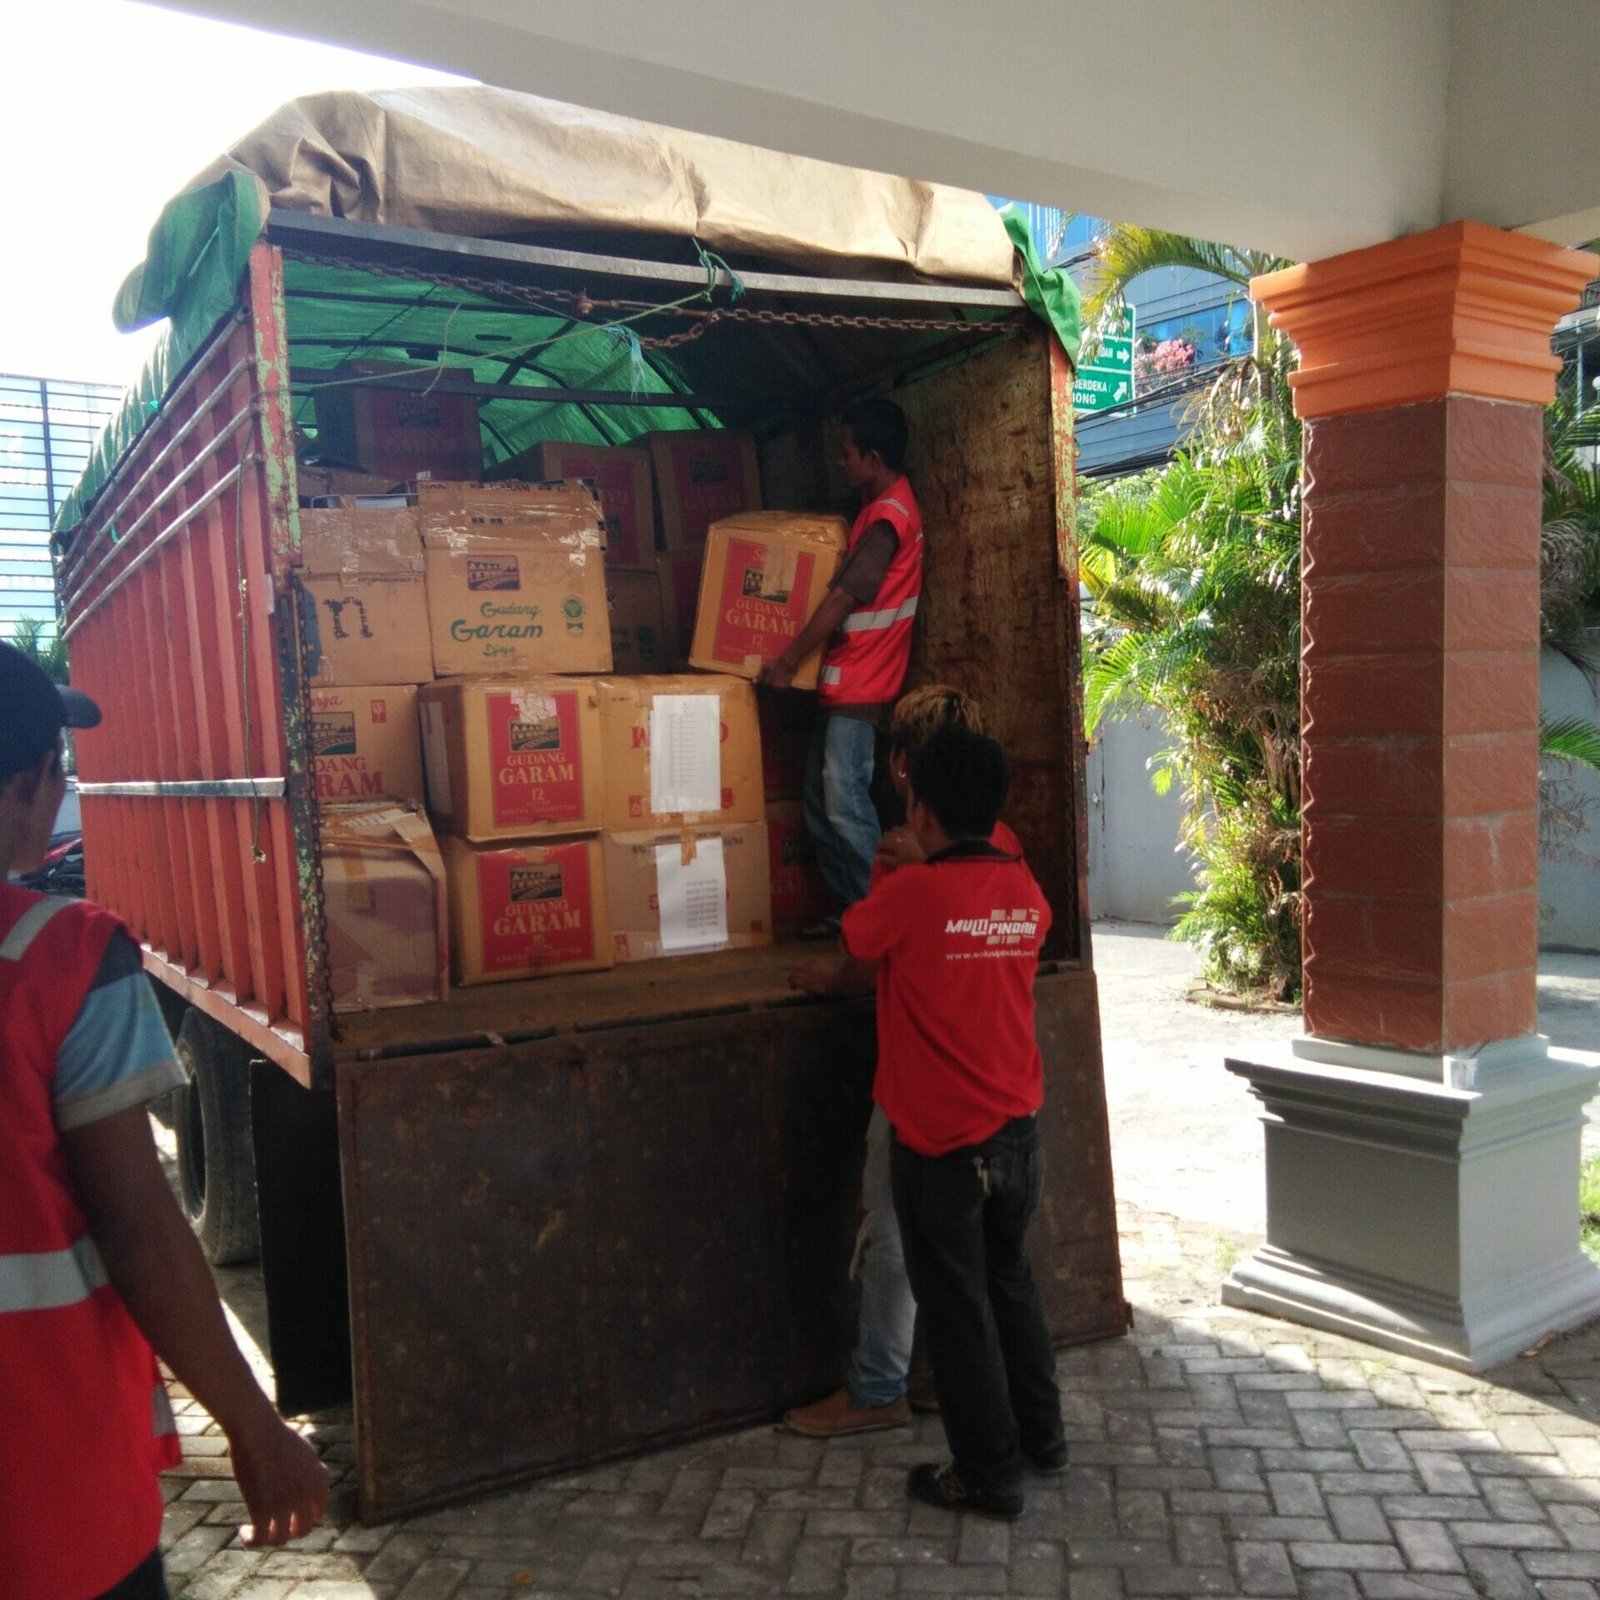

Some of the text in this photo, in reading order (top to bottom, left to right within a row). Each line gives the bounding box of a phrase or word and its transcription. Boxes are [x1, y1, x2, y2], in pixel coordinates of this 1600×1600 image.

[481, 601, 541, 621] Gudang
[735, 599, 790, 618] GUDANG
[451, 619, 543, 642] Garam
[725, 608, 797, 637] GARAM
[316, 757, 367, 773] DANG
[506, 752, 566, 767] GUDANG
[316, 771, 385, 797] RAM
[498, 763, 576, 786] GARAM
[504, 899, 570, 917] GUDANG
[492, 909, 581, 937] GARAM
